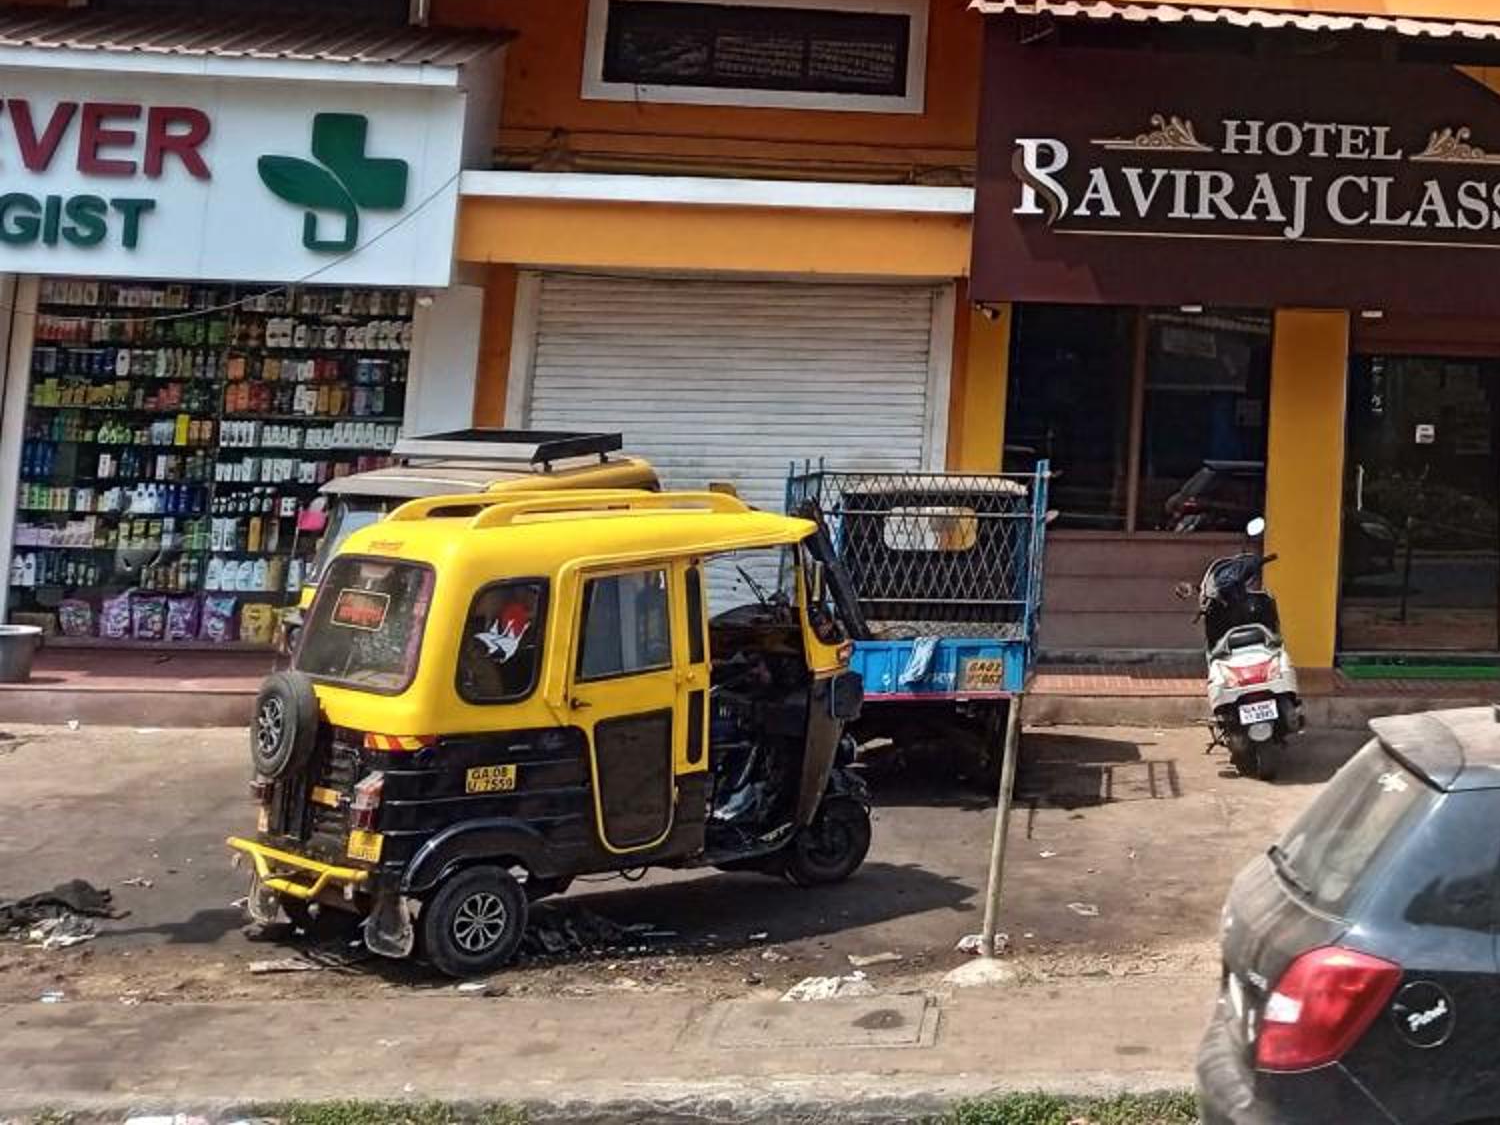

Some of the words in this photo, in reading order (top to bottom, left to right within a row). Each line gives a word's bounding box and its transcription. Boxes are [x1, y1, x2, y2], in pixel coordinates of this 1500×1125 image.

[0, 98, 212, 180] VER
[1221, 120, 1402, 160] HOTEL
[1011, 138, 1312, 238] RAVIRAJ
